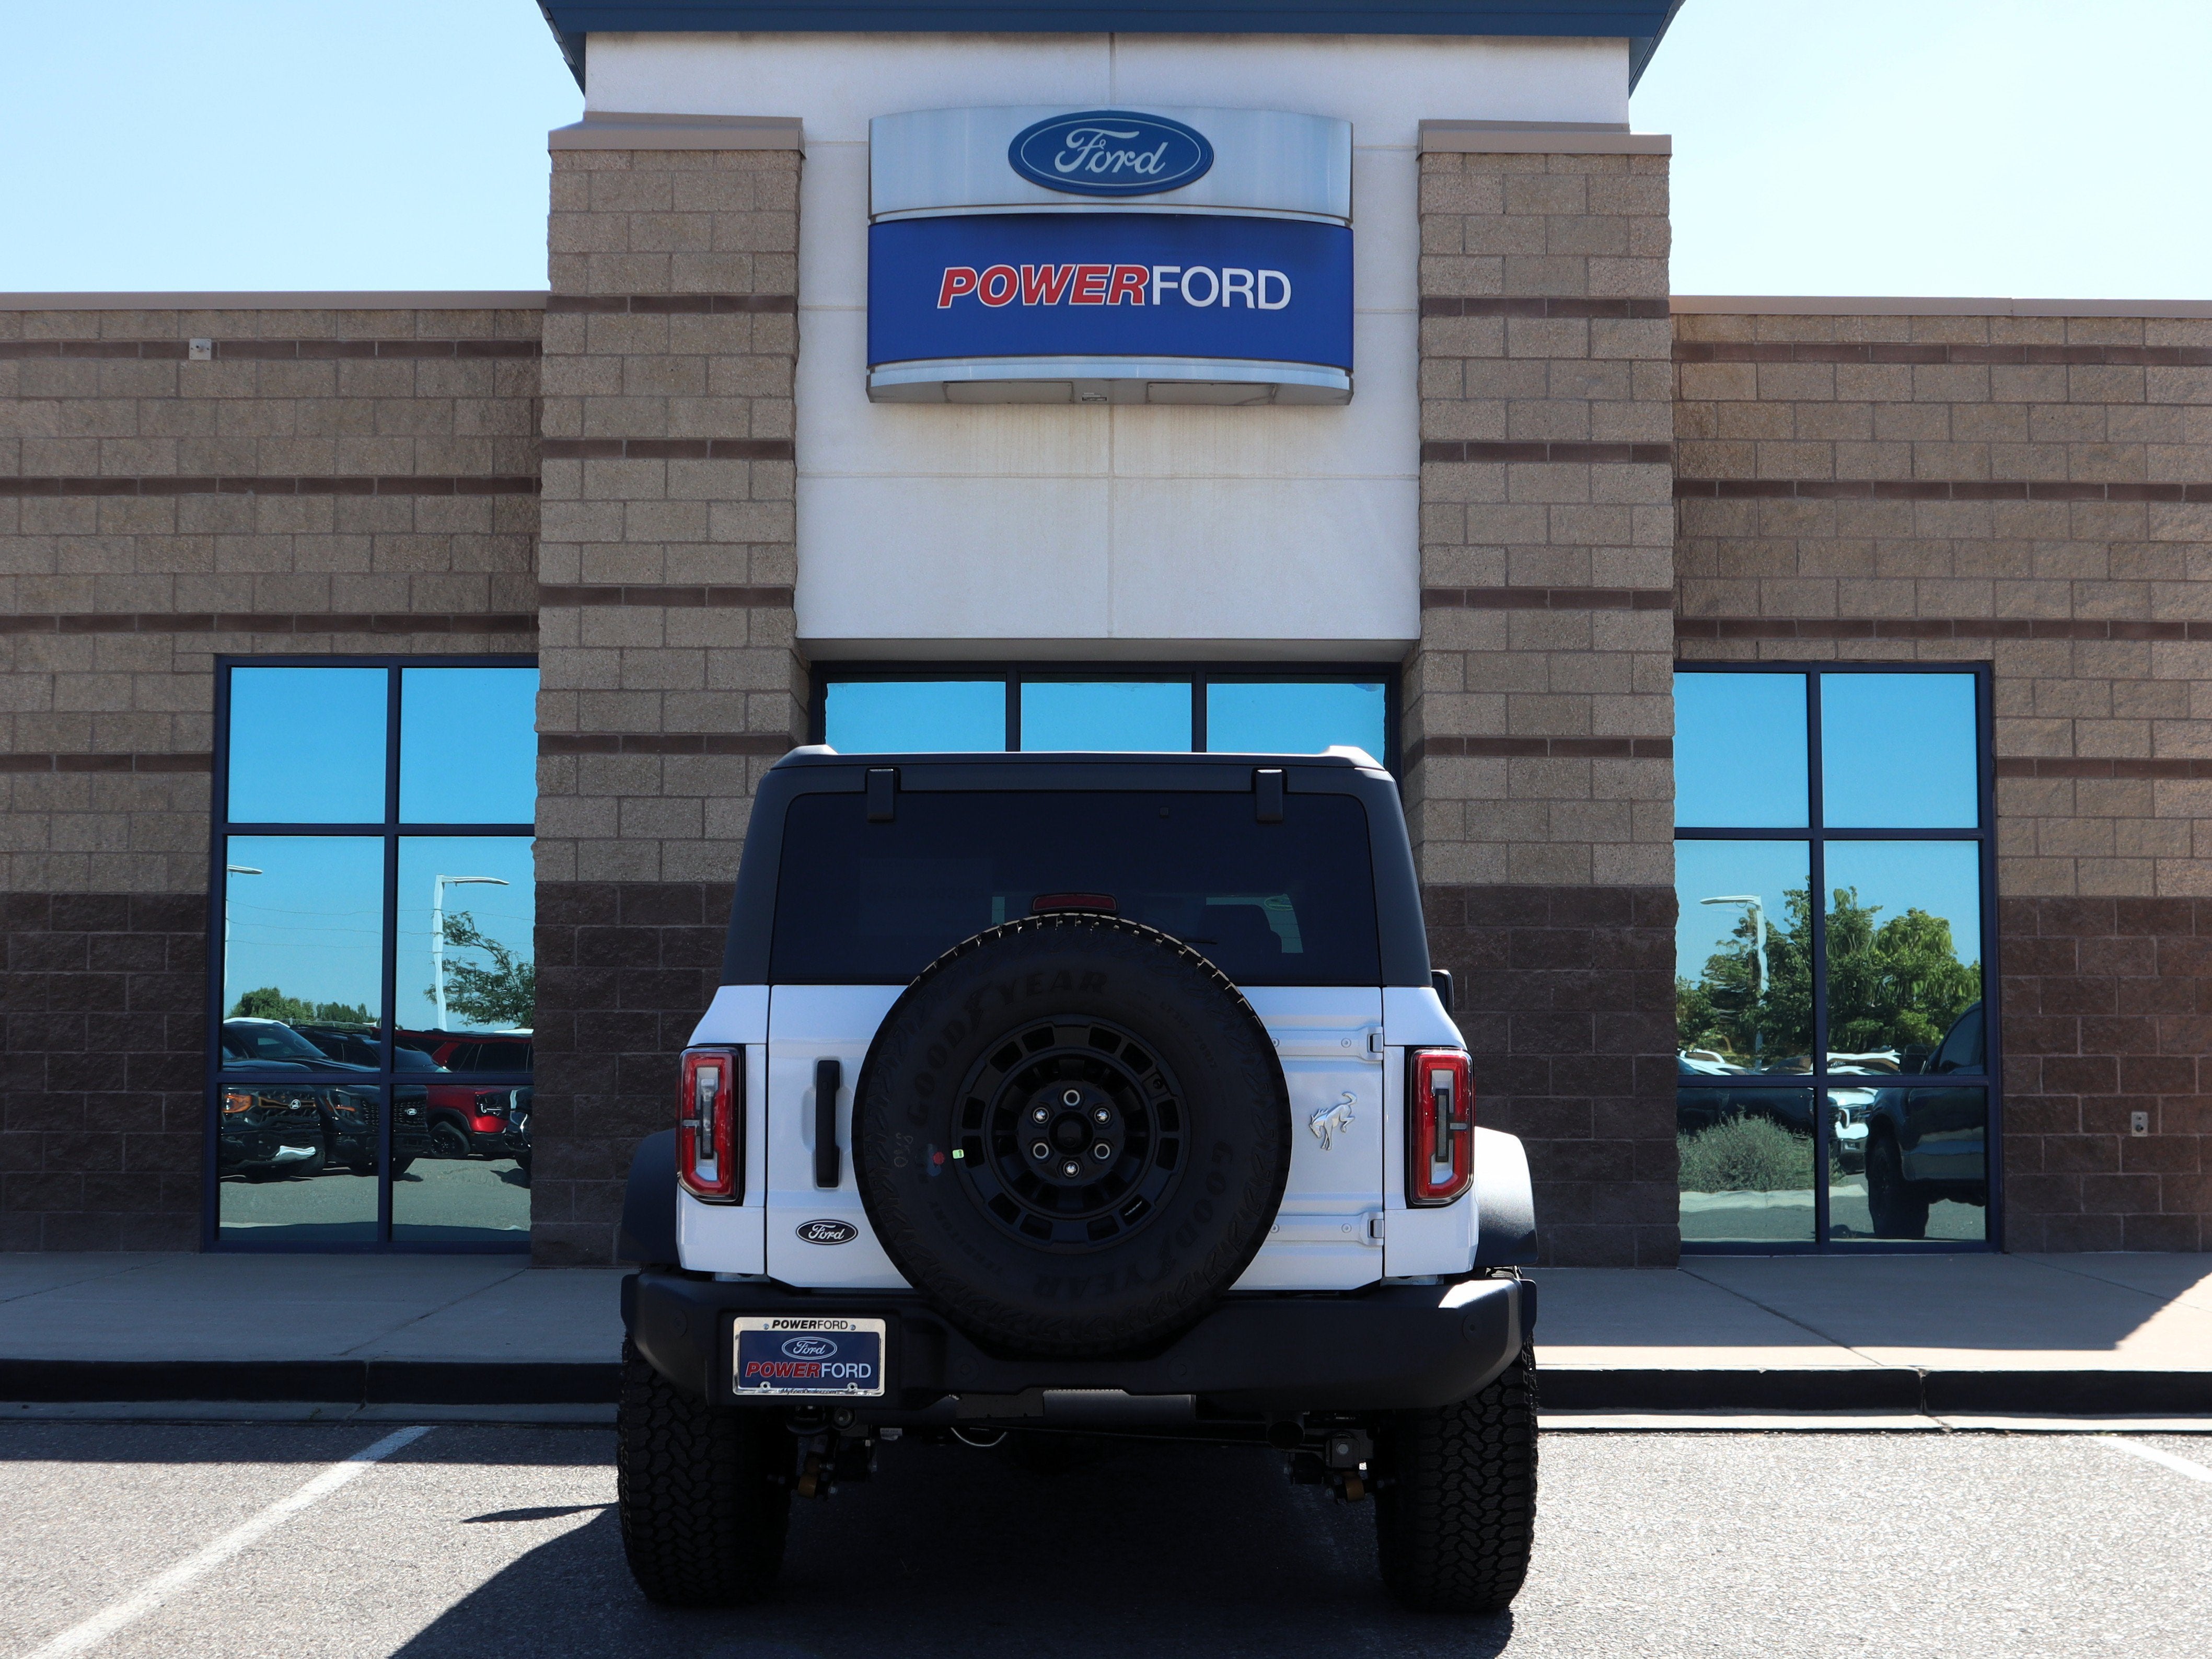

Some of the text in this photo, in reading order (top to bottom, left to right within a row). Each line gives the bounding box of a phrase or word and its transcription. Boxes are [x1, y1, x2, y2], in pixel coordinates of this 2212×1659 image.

[1054, 127, 1169, 176] Ford
[936, 263, 1292, 309] POWERFORD
[808, 1224, 846, 1240] Ford
[772, 1319, 848, 1330] POWERFORD
[793, 1340, 826, 1355] Ford
[745, 1361, 872, 1379] POWERFORD
